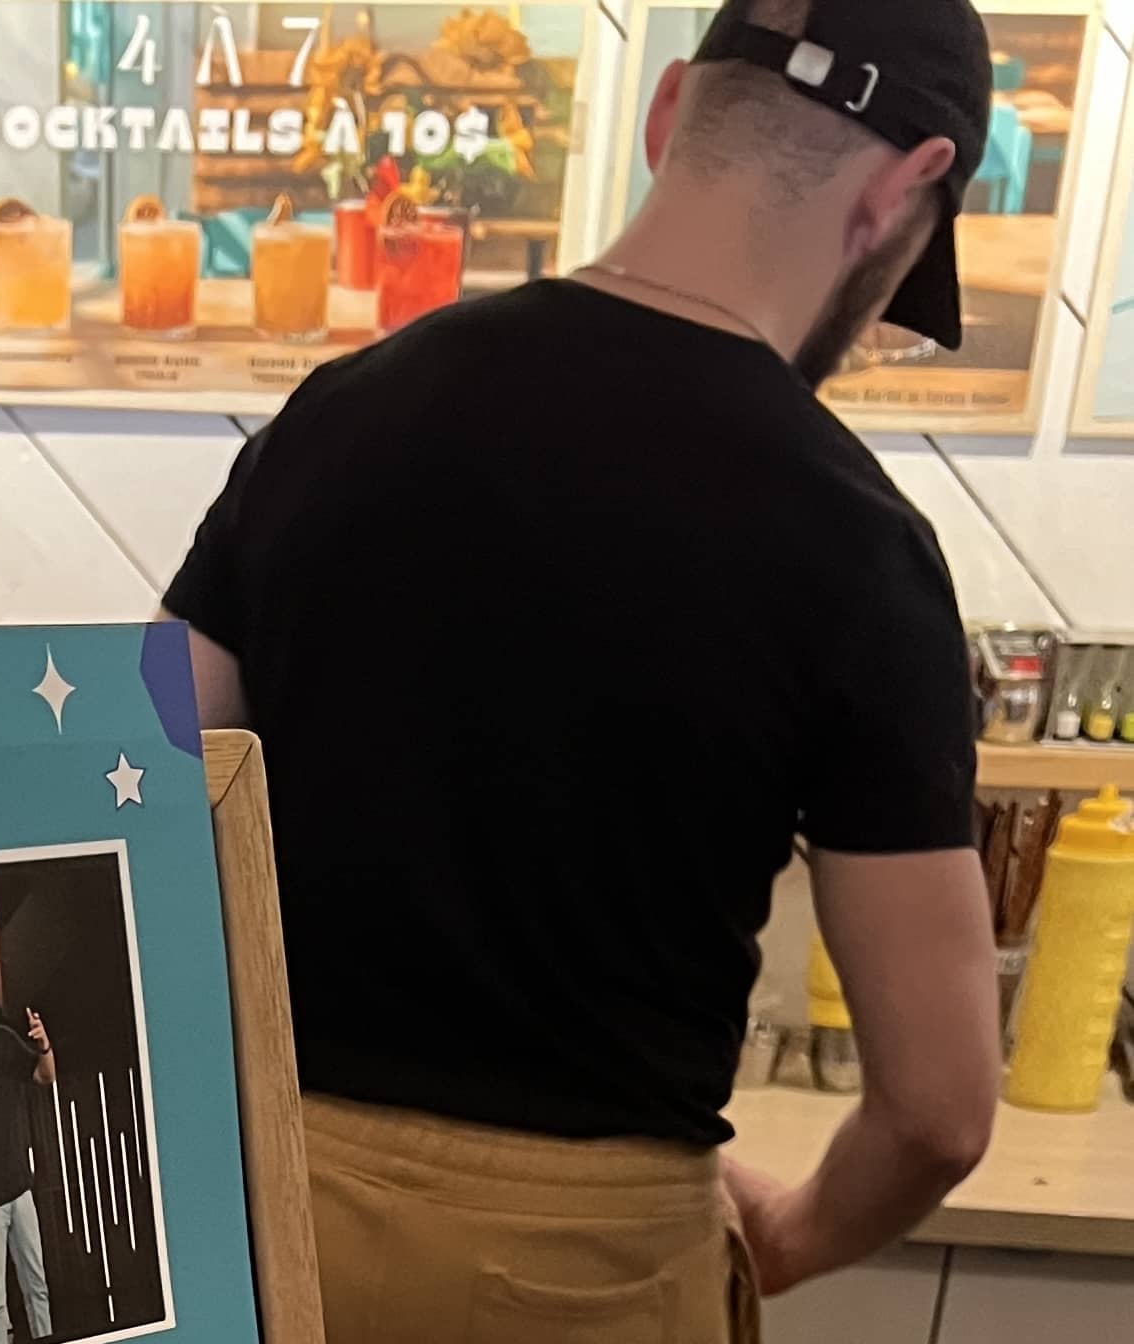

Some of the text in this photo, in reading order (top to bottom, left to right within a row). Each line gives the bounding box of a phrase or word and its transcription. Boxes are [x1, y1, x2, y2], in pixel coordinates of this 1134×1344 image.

[118, 14, 162, 87] 4
[282, 16, 322, 87] 7
[323, 96, 363, 155] À
[381, 105, 493, 163] 10$
